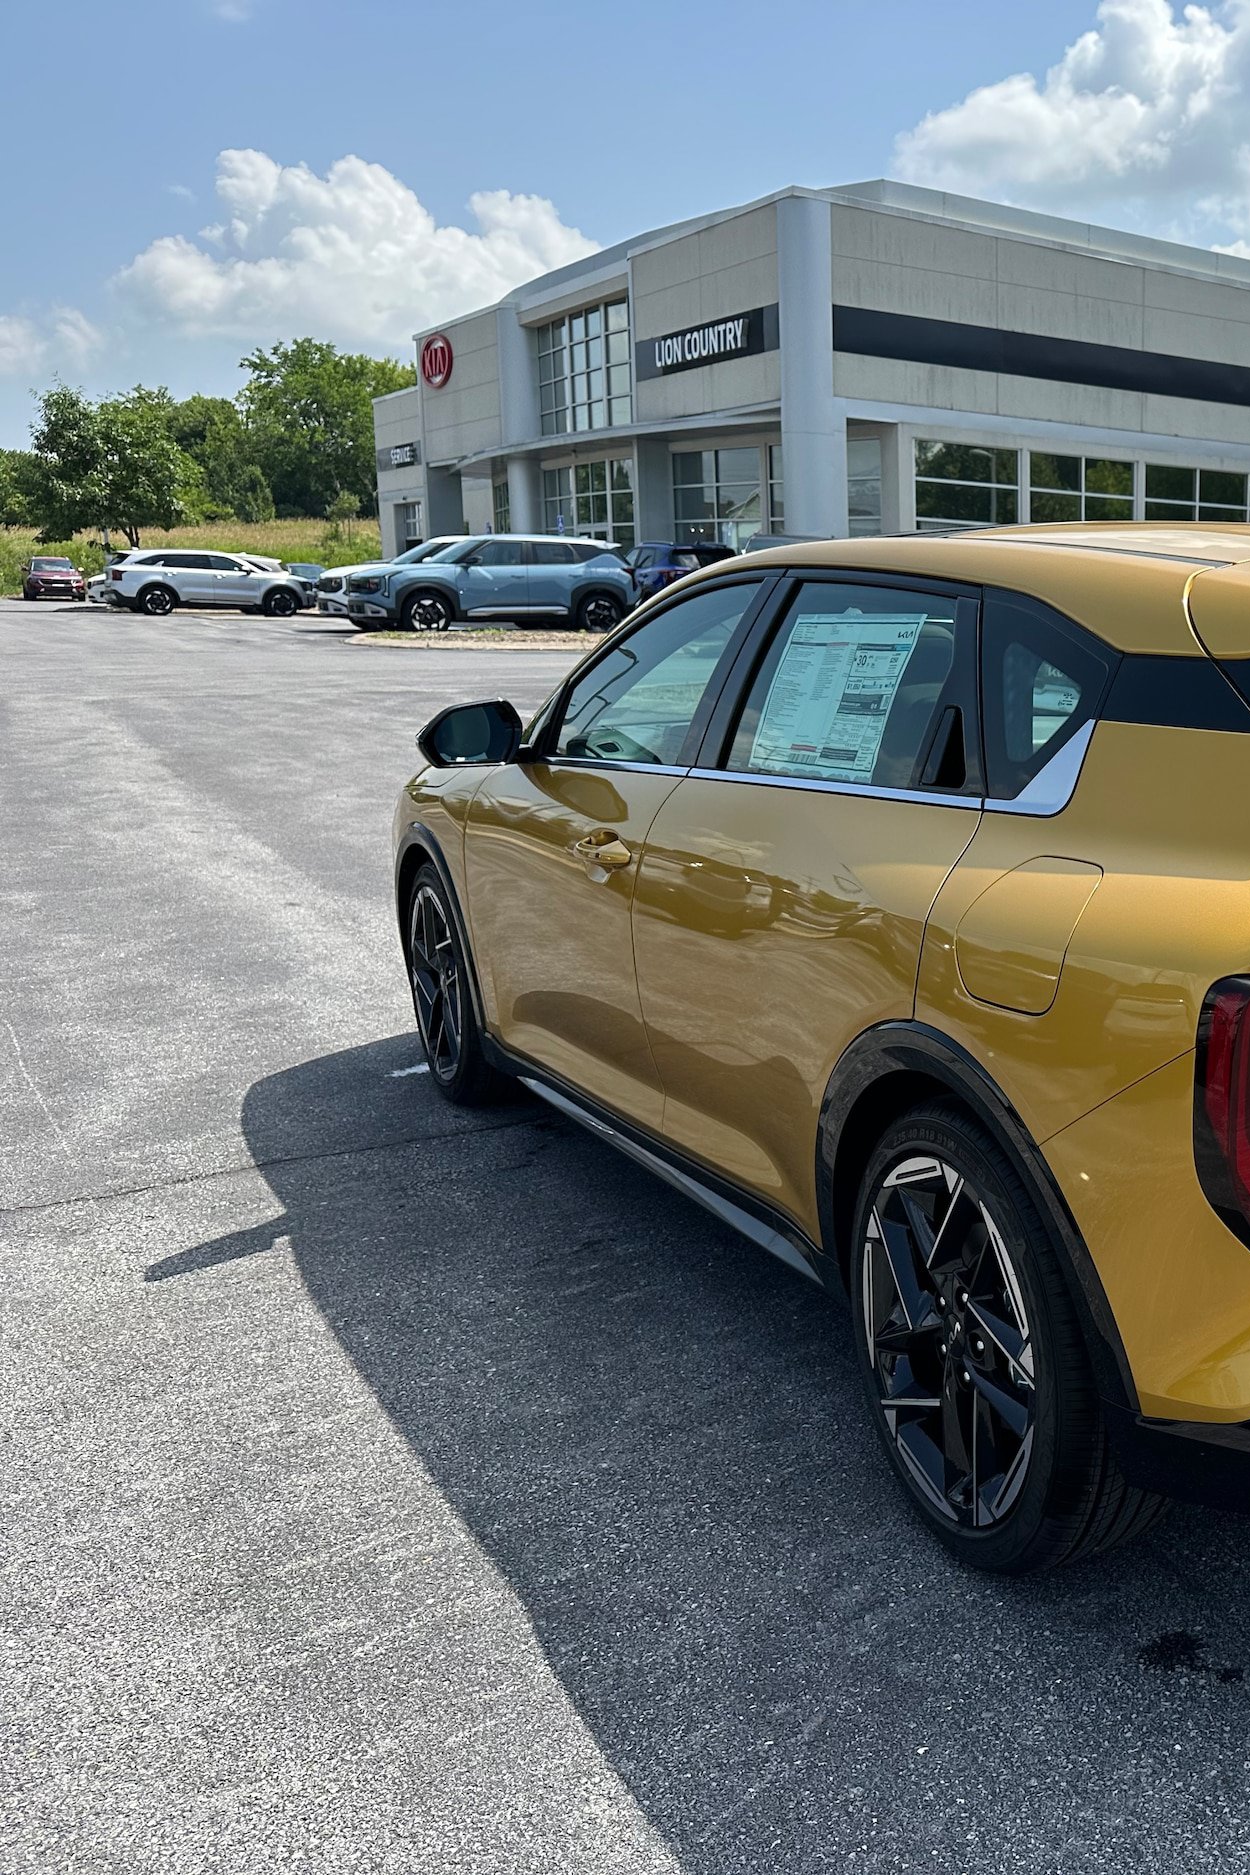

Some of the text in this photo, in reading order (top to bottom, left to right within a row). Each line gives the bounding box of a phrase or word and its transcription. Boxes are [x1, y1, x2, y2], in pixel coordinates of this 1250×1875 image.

[655, 319, 744, 368] LION COUNTRY
[424, 347, 445, 378] KIA
[390, 446, 412, 465] SERVICE
[897, 631, 914, 639] KIA
[856, 654, 868, 666] 30
[919, 1128, 935, 1140] R18
